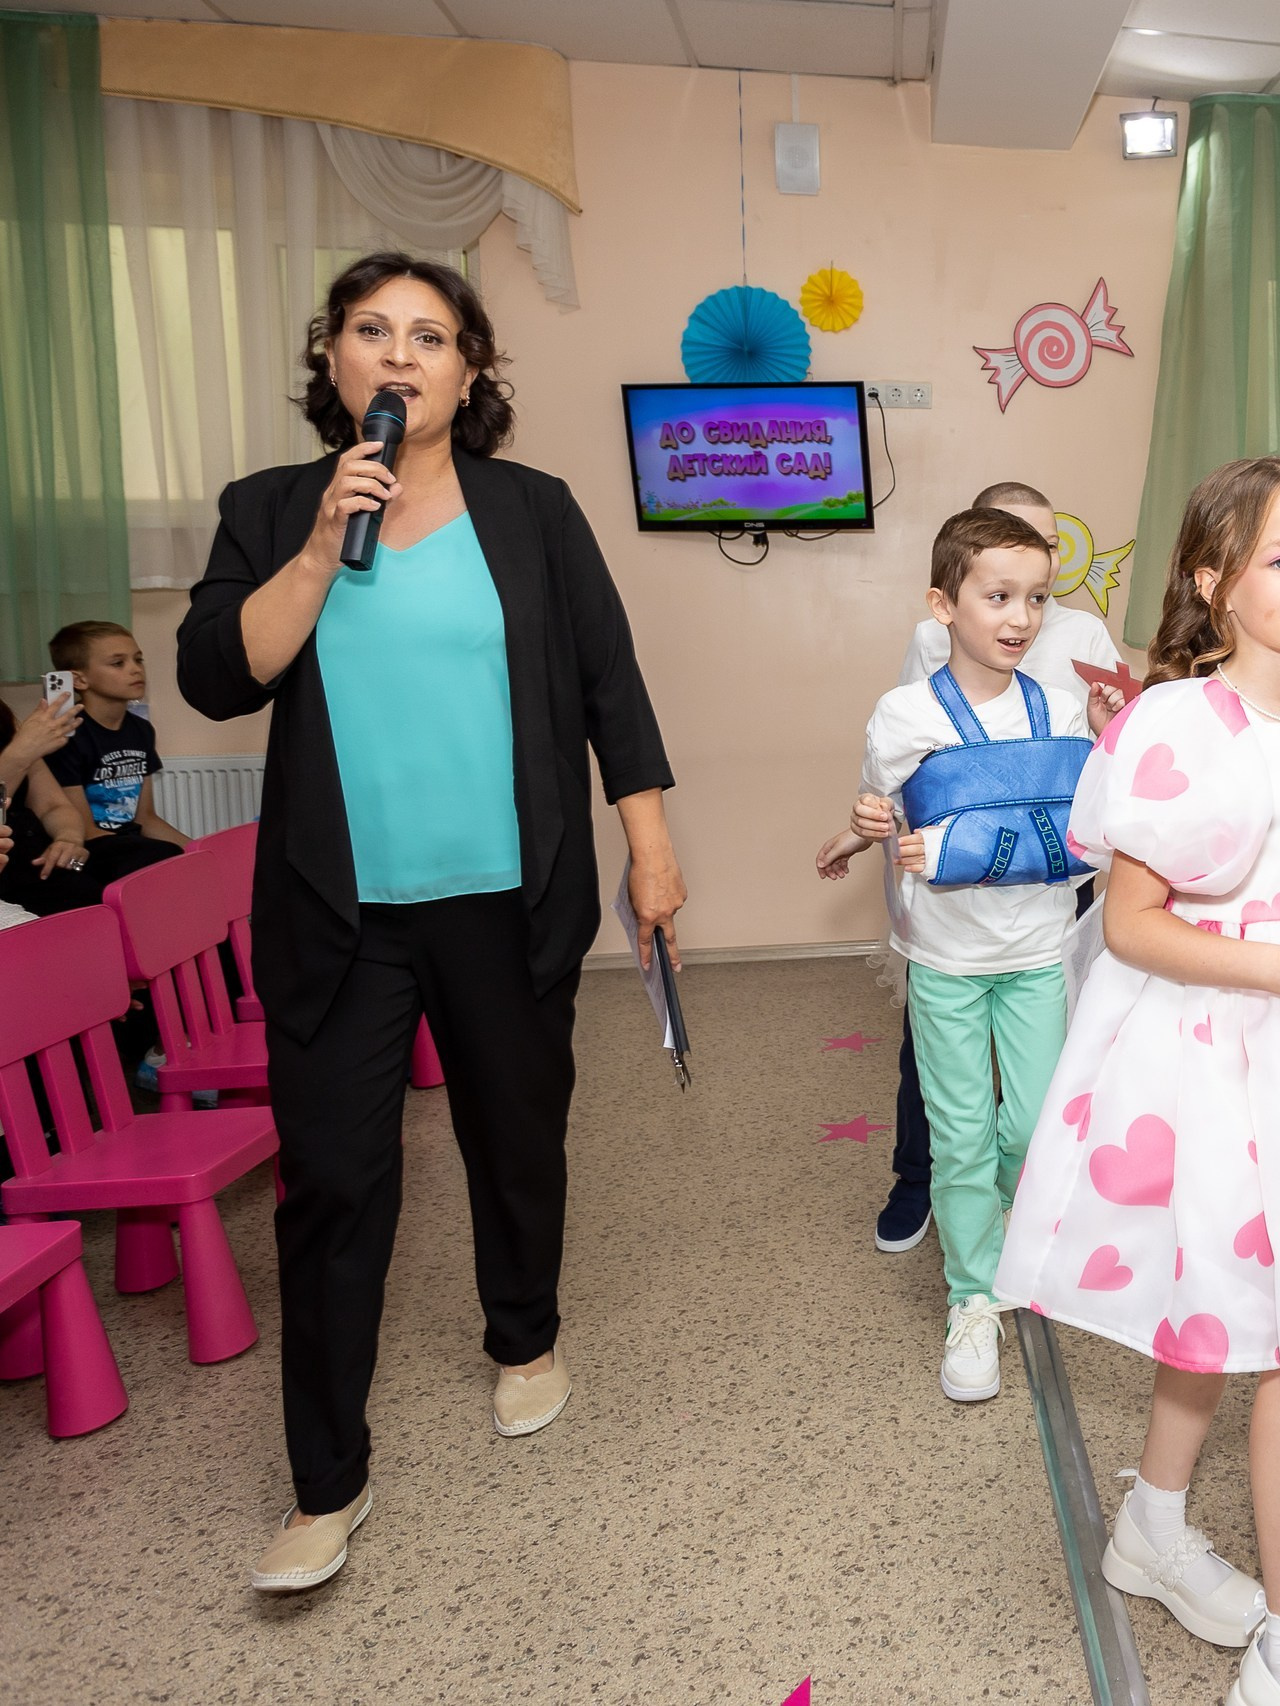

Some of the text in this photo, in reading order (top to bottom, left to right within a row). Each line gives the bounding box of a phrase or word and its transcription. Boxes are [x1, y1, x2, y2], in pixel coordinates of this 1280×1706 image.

[659, 419, 832, 450] ДО СВИДАНИЯ,
[667, 450, 832, 481] ДЕТСКИЙ САД!
[93, 767, 113, 781] LOS
[115, 761, 147, 777] ANGELE
